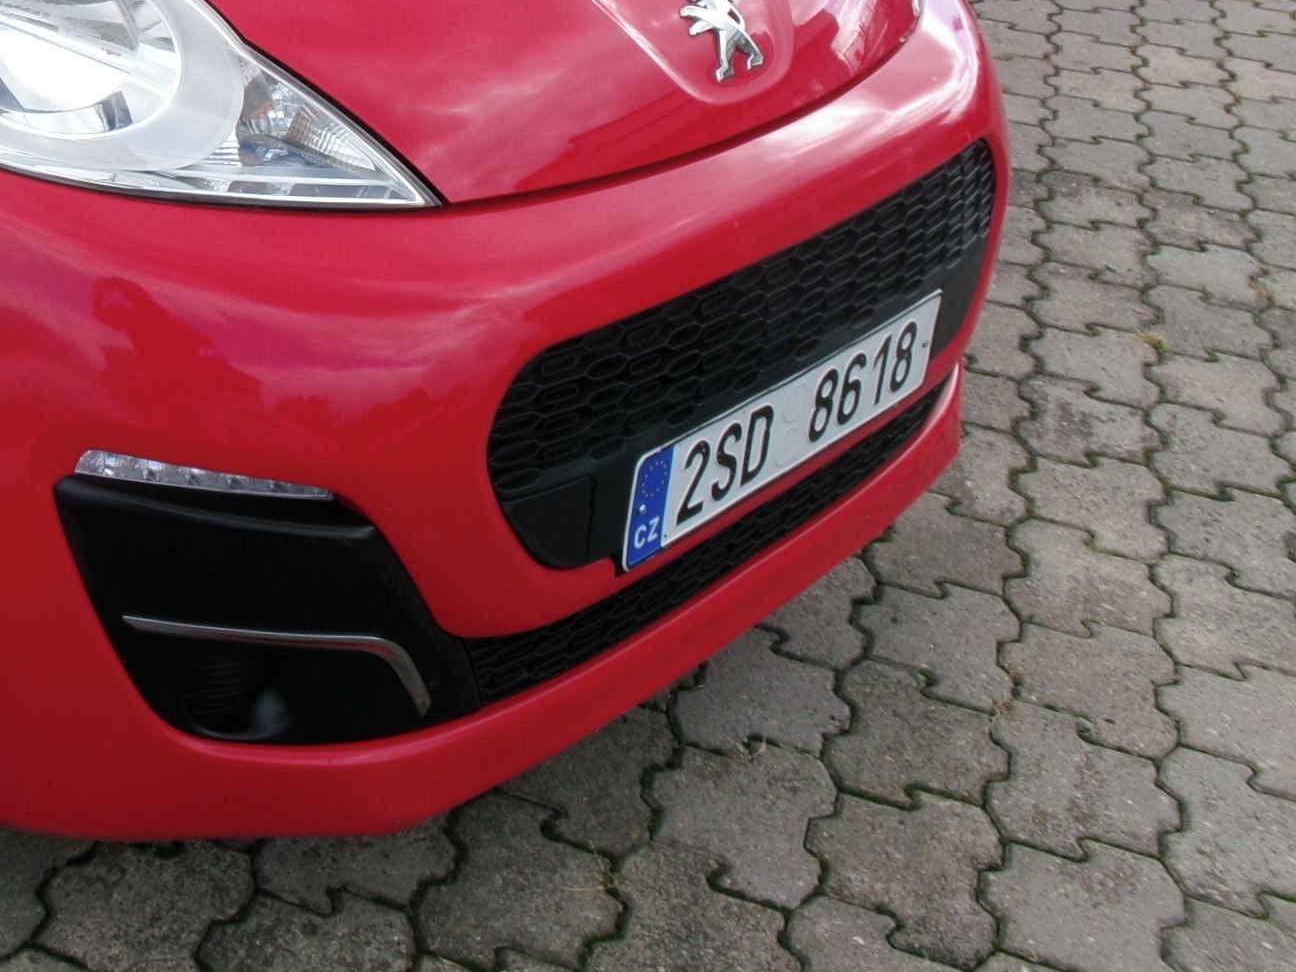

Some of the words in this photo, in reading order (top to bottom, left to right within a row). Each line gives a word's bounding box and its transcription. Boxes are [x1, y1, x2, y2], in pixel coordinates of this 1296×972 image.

[675, 404, 774, 526] 2SD
[808, 321, 918, 443] 8618
[633, 516, 660, 549] CZ
